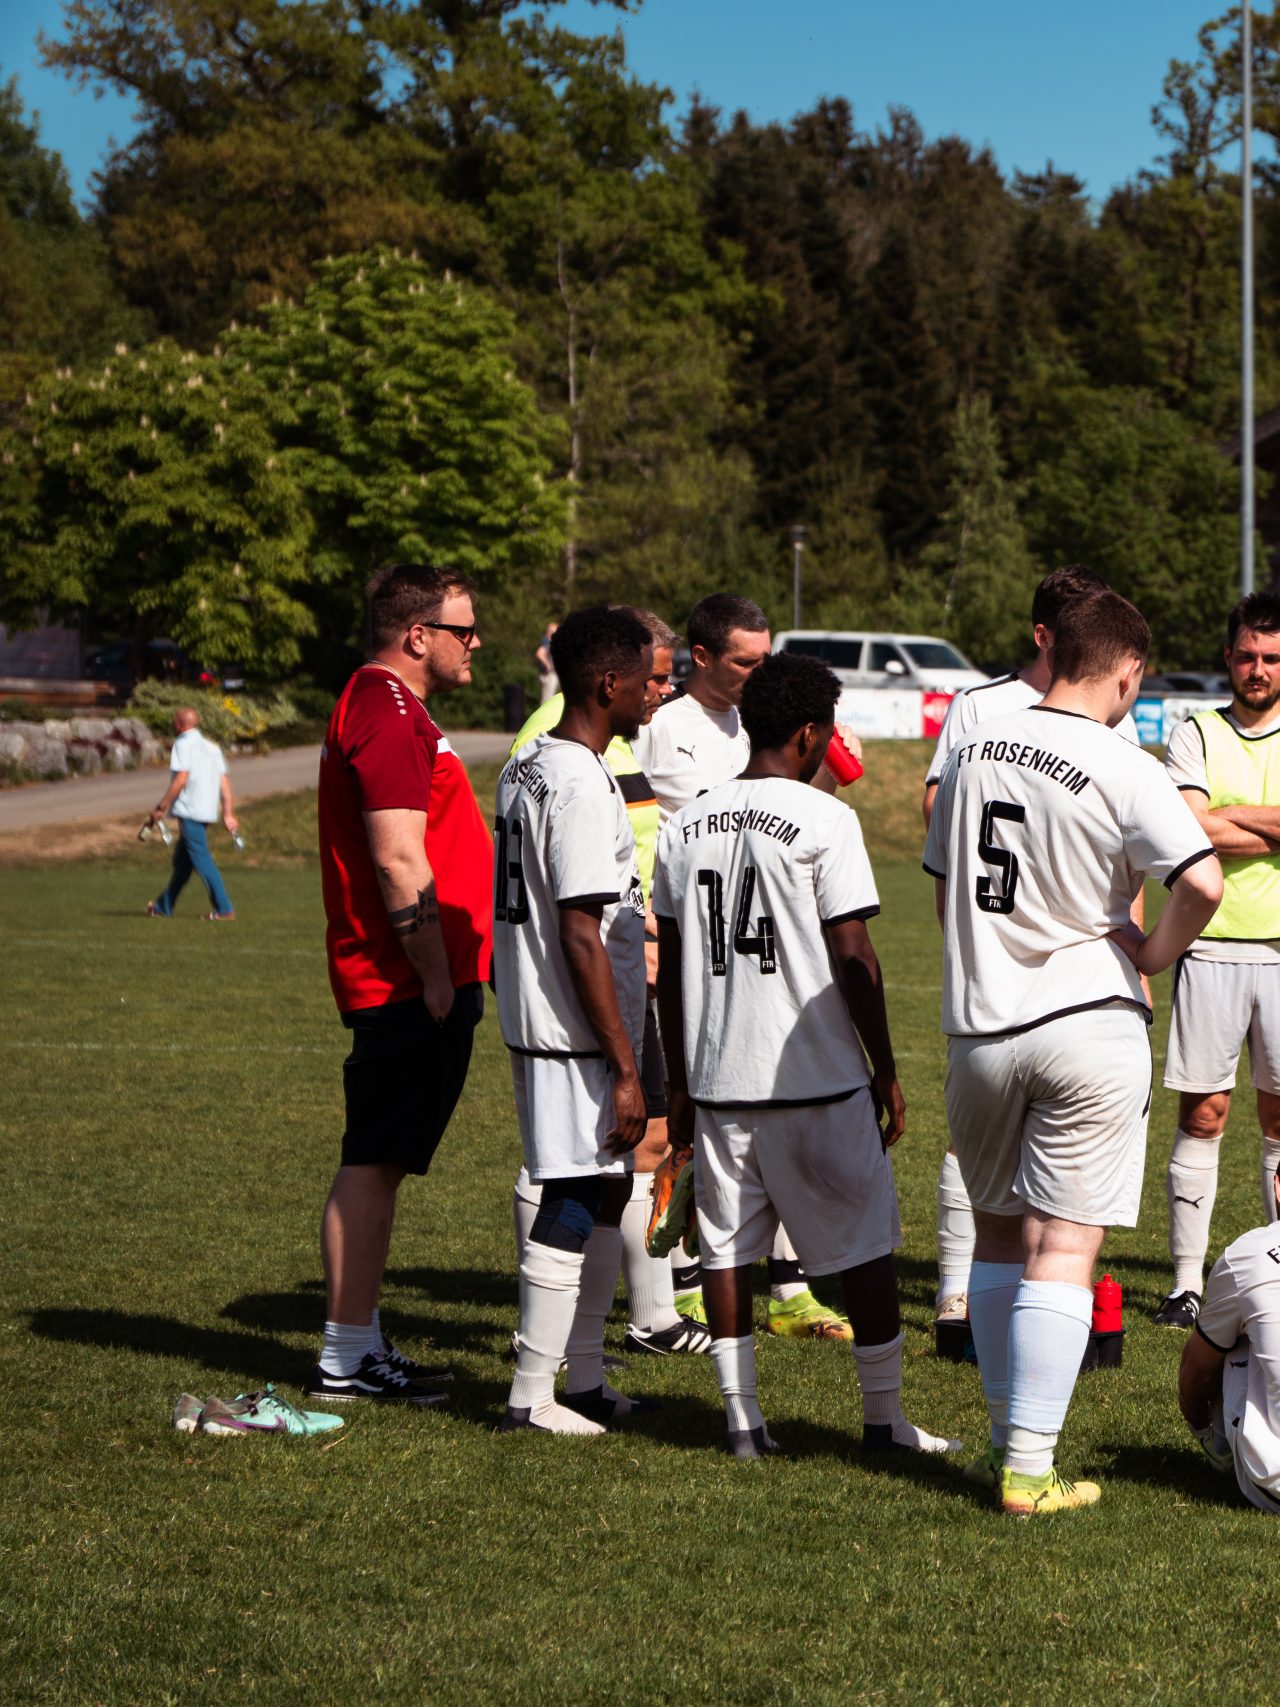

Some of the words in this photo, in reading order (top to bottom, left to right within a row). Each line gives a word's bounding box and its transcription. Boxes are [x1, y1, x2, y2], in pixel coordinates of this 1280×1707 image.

[958, 743, 977, 769] FT
[980, 741, 1091, 796] ROSENHEIM
[494, 815, 530, 925] 13
[682, 819, 702, 844] FT
[976, 800, 1026, 915] 5
[697, 866, 777, 977] 14
[762, 960, 774, 968] FTR
